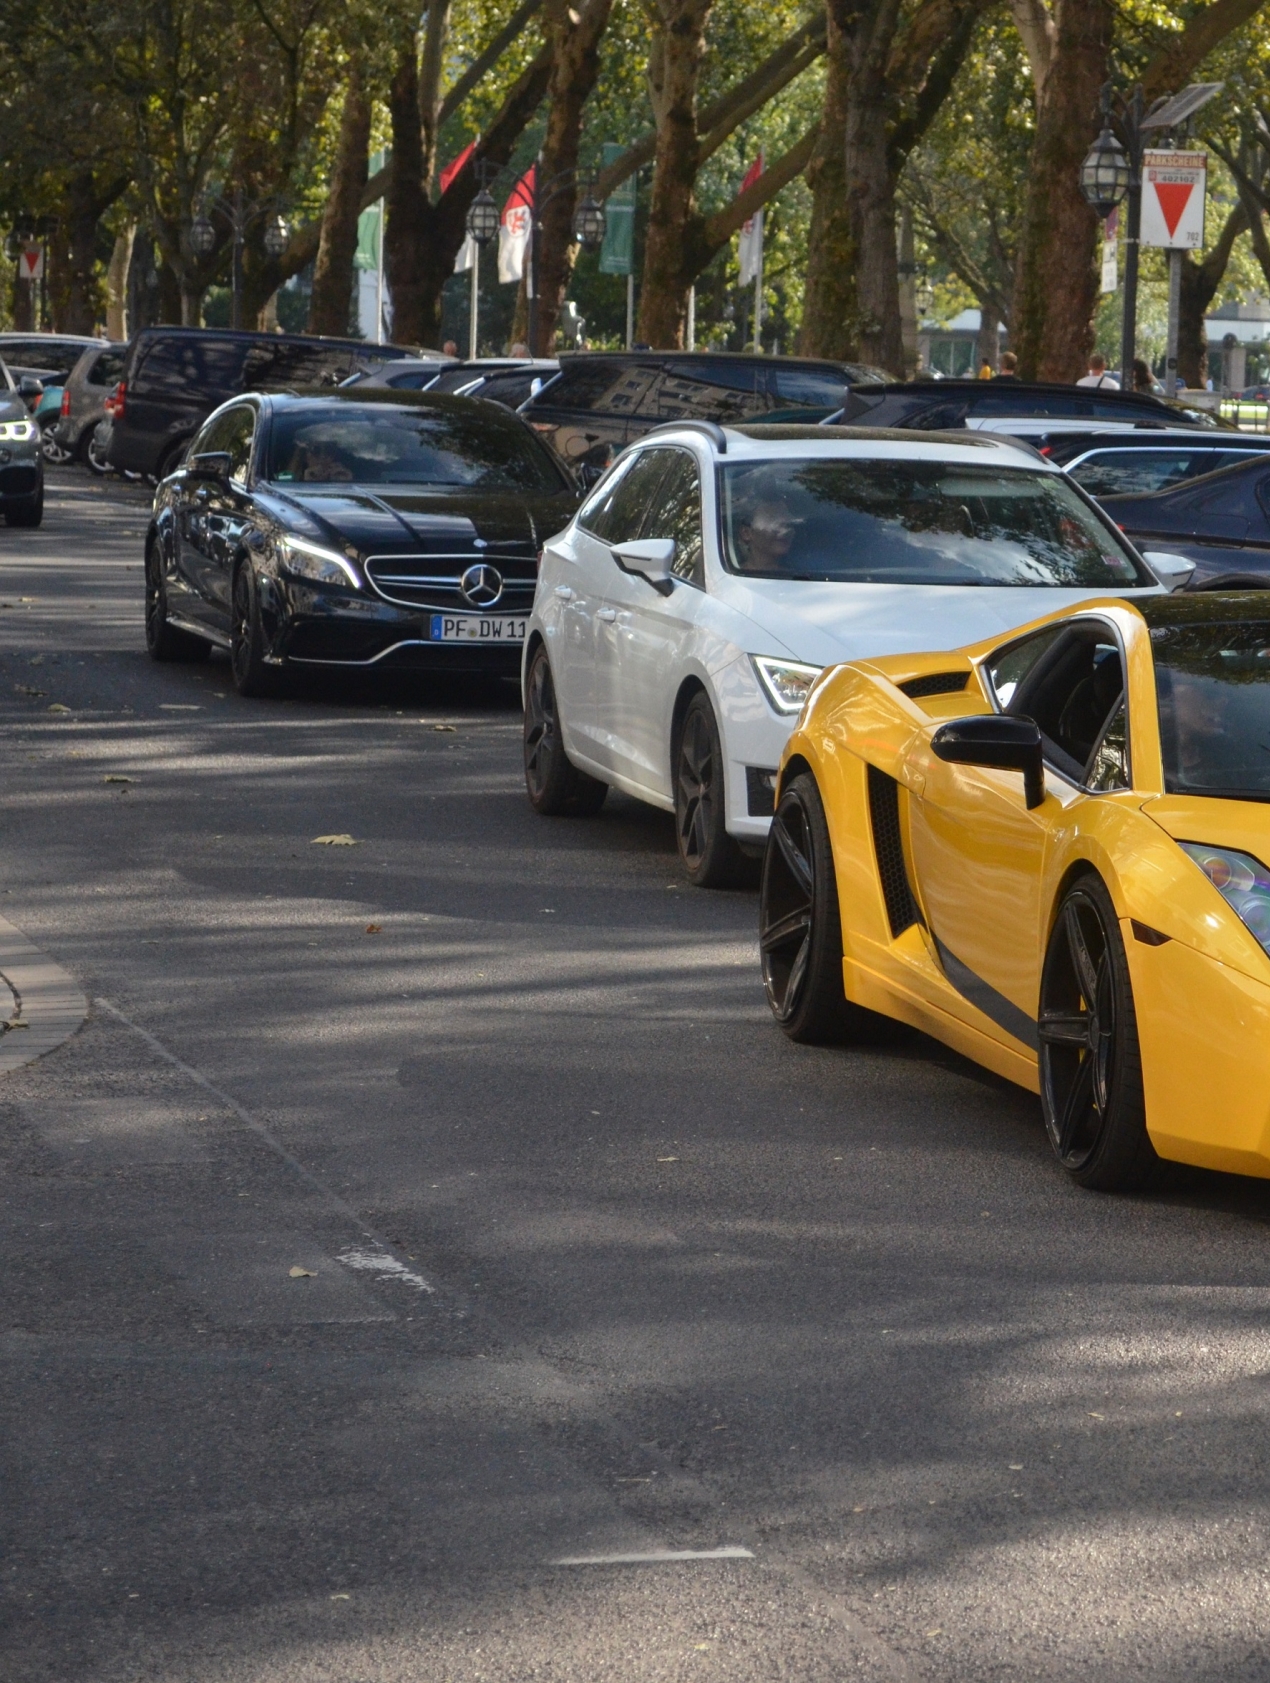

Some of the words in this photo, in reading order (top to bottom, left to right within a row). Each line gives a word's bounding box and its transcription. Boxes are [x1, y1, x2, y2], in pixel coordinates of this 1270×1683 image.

[1144, 155, 1204, 167] PARKSCHEINE
[1187, 232, 1199, 241] 702
[444, 619, 467, 637] PF
[479, 620, 502, 638] DW
